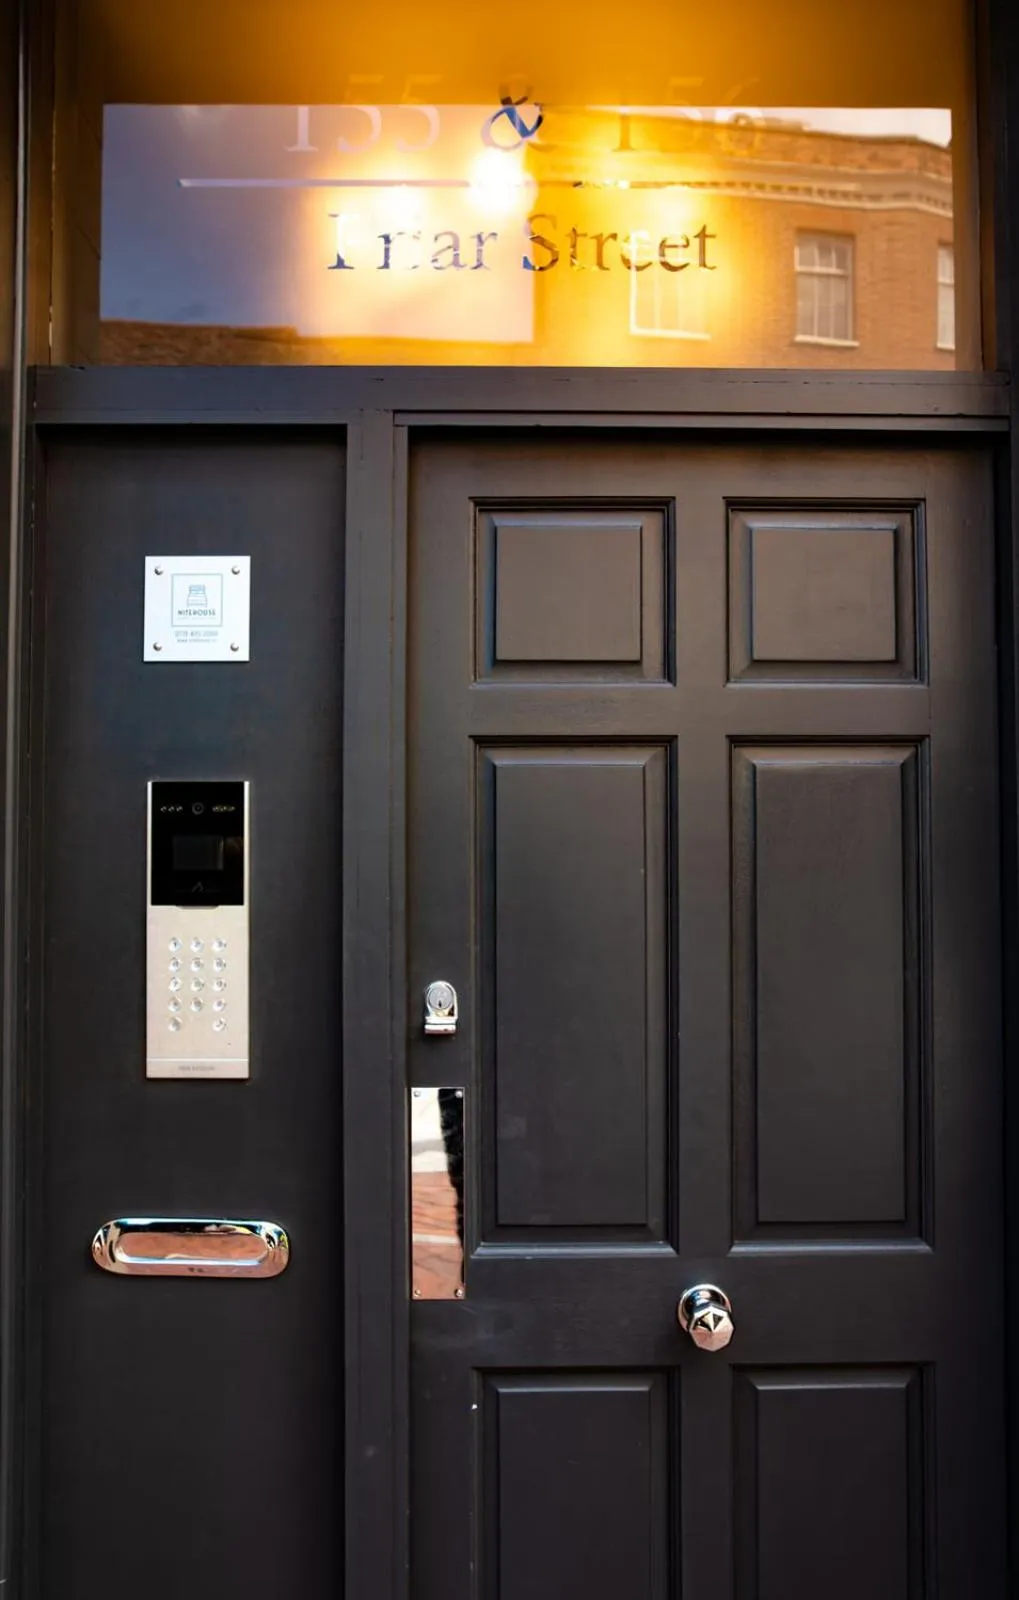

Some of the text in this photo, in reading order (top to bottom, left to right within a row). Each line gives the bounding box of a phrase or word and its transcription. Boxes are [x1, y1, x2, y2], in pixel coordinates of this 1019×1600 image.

[283, 73, 445, 153] 155
[480, 72, 558, 152] &
[522, 213, 717, 272] Street
